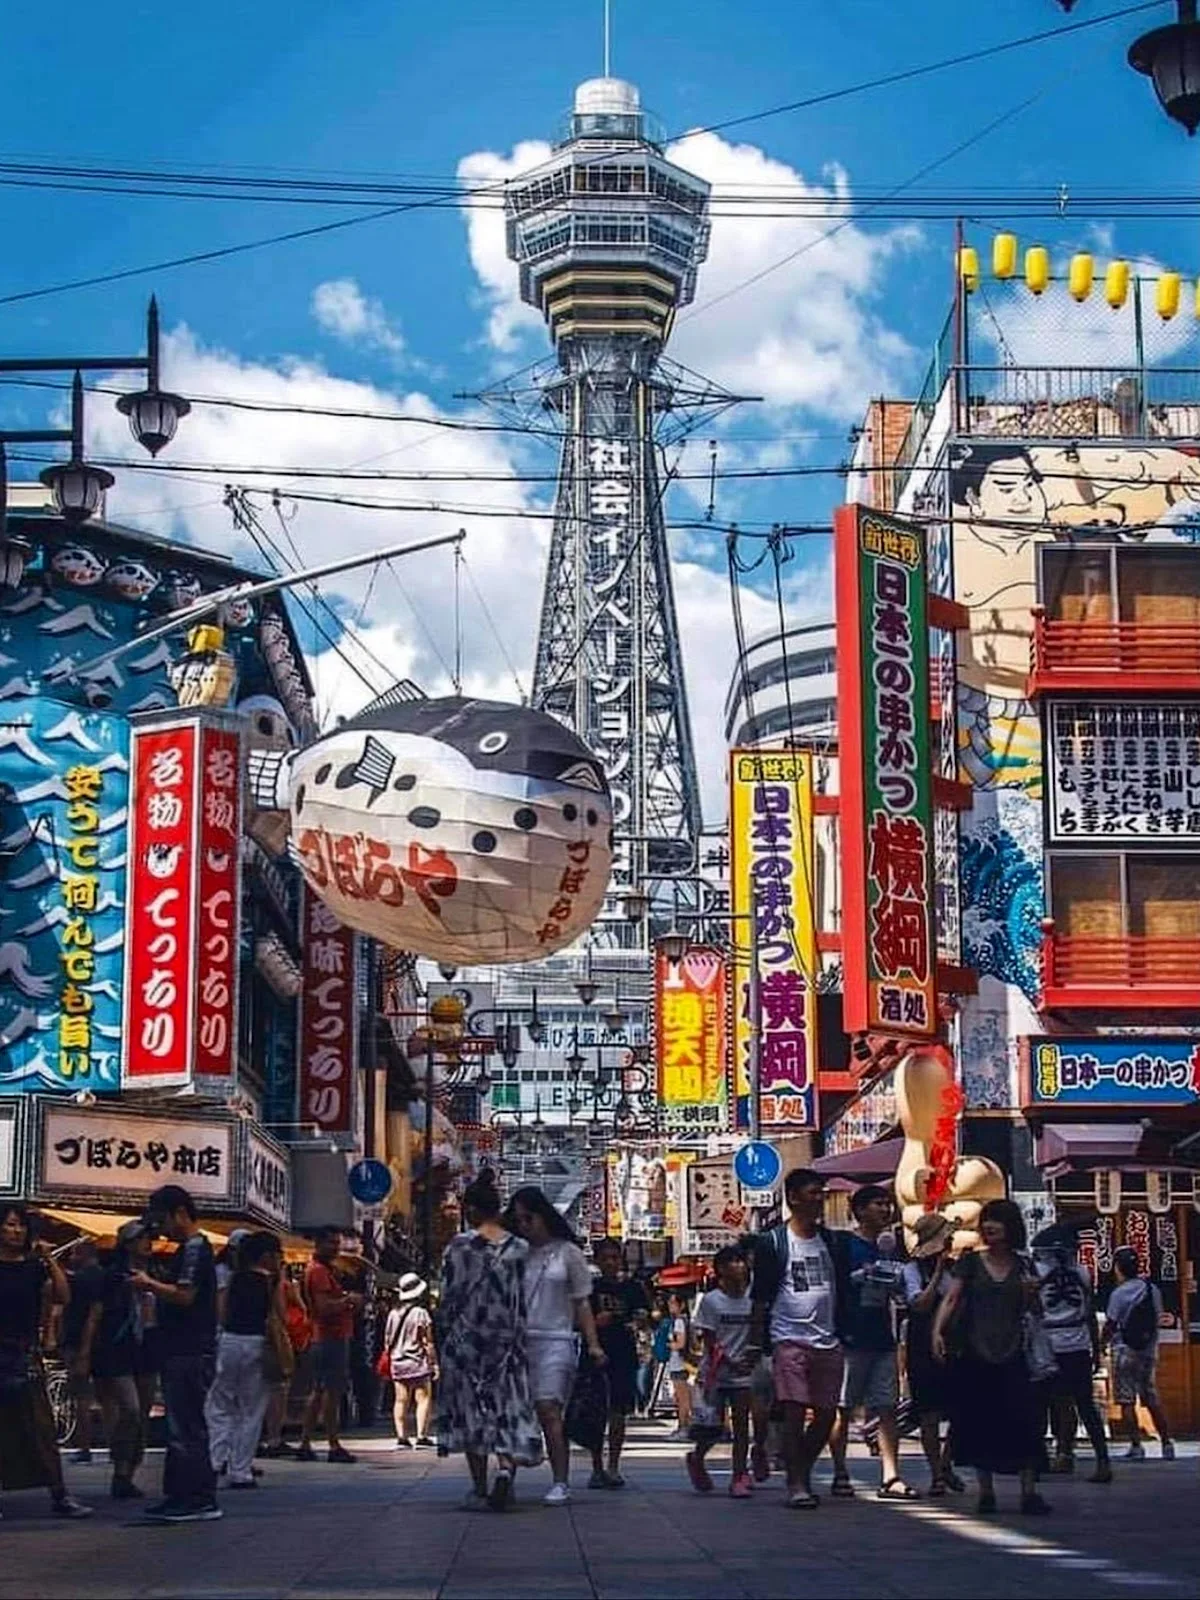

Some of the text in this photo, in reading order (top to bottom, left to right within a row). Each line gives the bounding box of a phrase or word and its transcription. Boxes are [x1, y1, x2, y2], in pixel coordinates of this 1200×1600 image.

[869, 560, 928, 985] 日本一の串かつ 横綱
[1058, 768, 1078, 833] もち
[1121, 769, 1141, 833] にんにく
[1142, 769, 1163, 833] 玉ねぎ
[1164, 769, 1184, 833] 山芋
[142, 888, 180, 1058] てっちり
[200, 889, 232, 1058] てっちり
[880, 985, 927, 1027] 酒処
[1060, 1055, 1189, 1088] 日本一の串かつ
[55, 1134, 222, 1177] づぼらや本店
